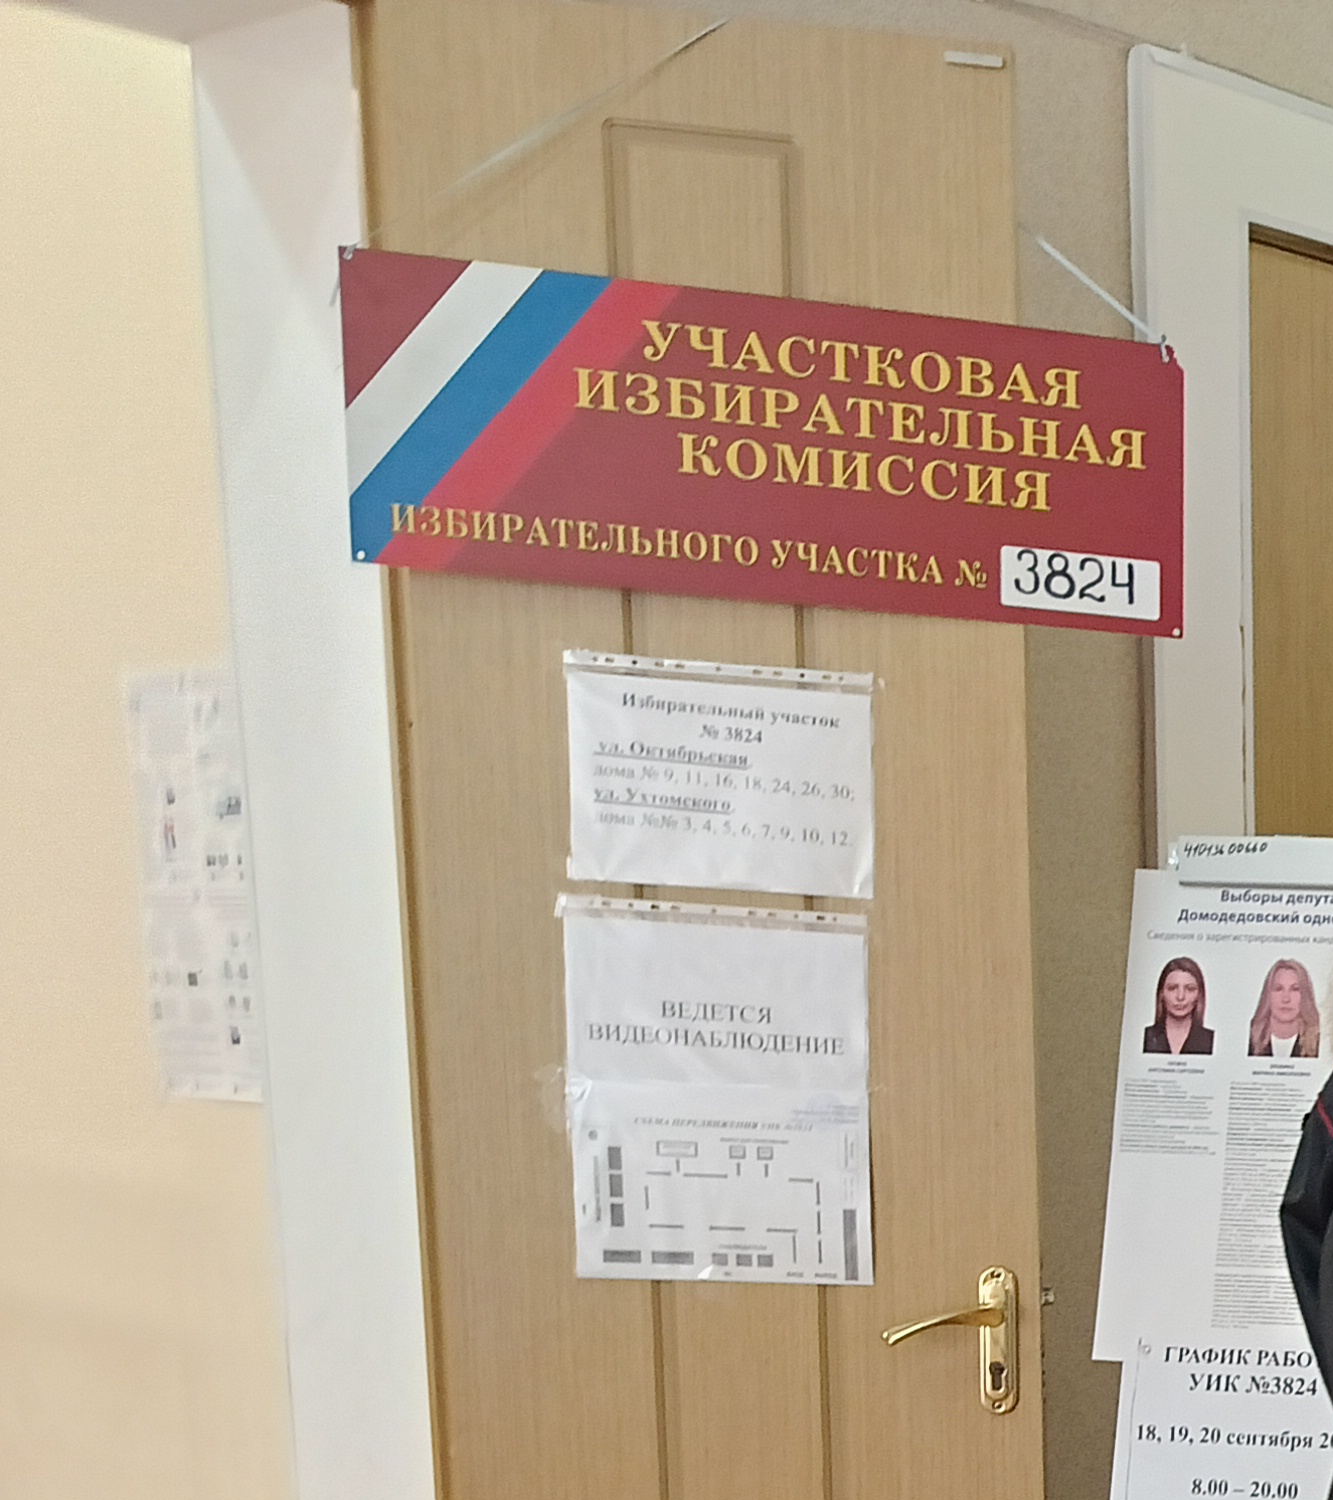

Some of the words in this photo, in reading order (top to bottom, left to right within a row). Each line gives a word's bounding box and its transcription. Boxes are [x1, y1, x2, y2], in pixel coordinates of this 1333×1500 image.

[641, 319, 1081, 409] УЧАСТКОВАЯ
[573, 366, 1147, 470] ИЗБИРАТЕЛЬНАЯ
[677, 432, 1051, 511] КОМИССИЯ
[390, 503, 759, 567] ИЗБИРАТЕЛЬНОГО
[770, 538, 944, 585] УЧАСТКА
[954, 559, 988, 589] №
[1013, 548, 1135, 605] 3824
[622, 692, 765, 721] Избирательный
[769, 711, 840, 730] участок
[724, 726, 763, 744] 3824
[1221, 889, 1283, 905] Выборы
[1178, 909, 1299, 925] Домодедовский
[660, 1000, 772, 1024] ВЕДЕТСЯ
[588, 1022, 845, 1056] ВИДЕОНАБЛЮДЕНИЕ
[1164, 1346, 1251, 1366] ГРАФИК
[1257, 1351, 1312, 1368] РАБО
[1189, 1373, 1240, 1393] УИК
[1245, 1375, 1317, 1396] №3824
[1137, 1424, 1161, 1445] 18,
[1169, 1425, 1193, 1445] 19,
[1200, 1427, 1221, 1444] 20
[1226, 1430, 1313, 1452] сентября
[1191, 1478, 1228, 1496] 8.00
[1249, 1482, 1299, 1500] 20.00
